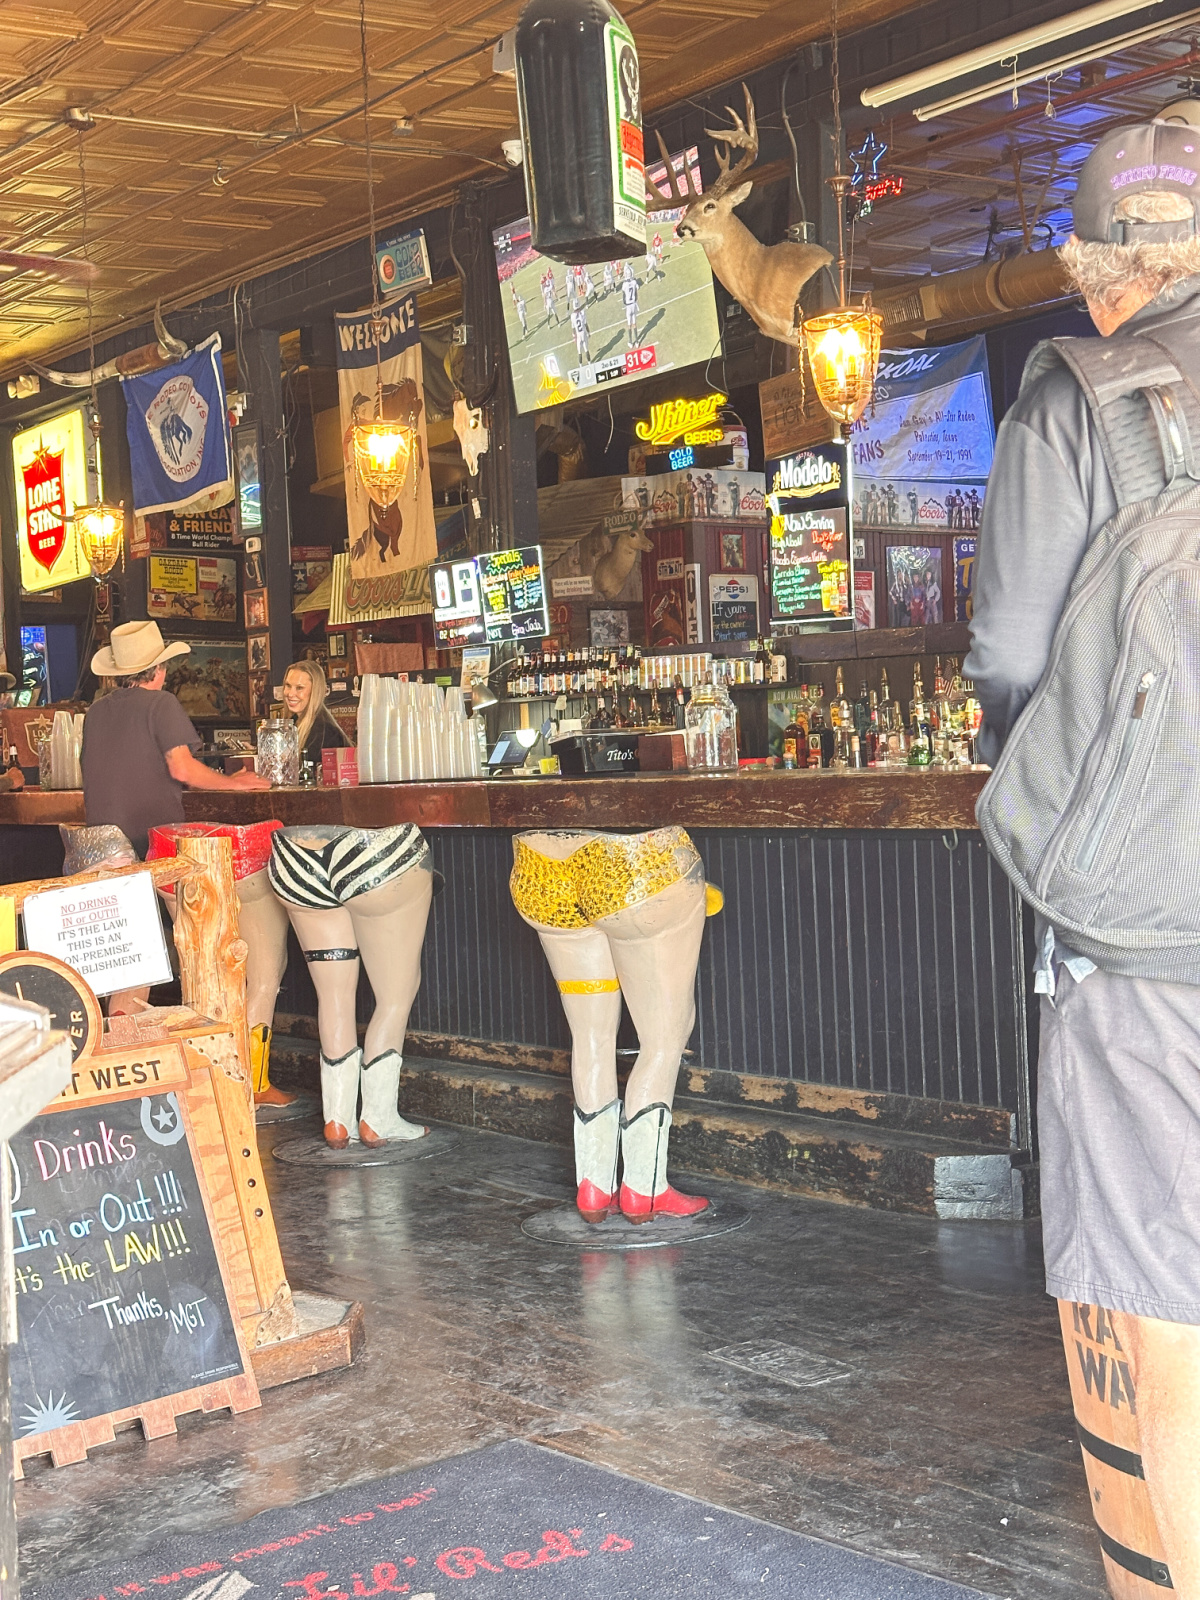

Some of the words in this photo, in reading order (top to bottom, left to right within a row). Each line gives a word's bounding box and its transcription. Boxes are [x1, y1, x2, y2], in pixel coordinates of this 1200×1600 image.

[1159, 165, 1197, 186] FROGS
[627, 351, 640, 368] 31
[635, 393, 727, 441] Shiner
[957, 410, 975, 422] Rodeo
[684, 429, 724, 446] BEERS
[943, 430, 957, 442] Texas
[669, 446, 693, 460] COLD
[853, 440, 885, 464] FANS
[908, 449, 932, 464] September
[935, 449, 955, 463] 19-21,
[958, 449, 972, 461] 1991
[671, 457, 693, 470] BEER
[780, 455, 832, 489] Modelo
[28, 476, 61, 511] LONE
[29, 504, 62, 536] STAR
[604, 511, 637, 529] RODEO
[919, 504, 946, 519] Coors
[170, 520, 180, 532] &
[784, 513, 804, 533] Now
[804, 511, 836, 535] Serving
[38, 536, 56, 550] BEER
[719, 586, 749, 594] PEPSI
[711, 602, 724, 617] If
[606, 749, 634, 763] Tito's
[61, 903, 76, 915] NO
[79, 894, 118, 911] DRINKS
[62, 917, 73, 927] IN
[76, 916, 86, 924] or
[89, 907, 119, 921] OUT!!!
[57, 929, 76, 941] IT'S
[78, 924, 101, 937] THE
[103, 918, 128, 932] LAW!
[67, 938, 92, 952] THIS
[95, 935, 105, 946] IS
[108, 932, 122, 944] AN
[90, 1060, 162, 1091] WEST
[33, 1120, 137, 1182] Drinks
[12, 1208, 59, 1255] In
[69, 1218, 93, 1239] or
[53, 1252, 95, 1285] the
[169, 1297, 207, 1335] MGT
[230, 1523, 340, 1563] meant
[339, 1511, 377, 1525] to
[436, 1528, 635, 1580] Red's
